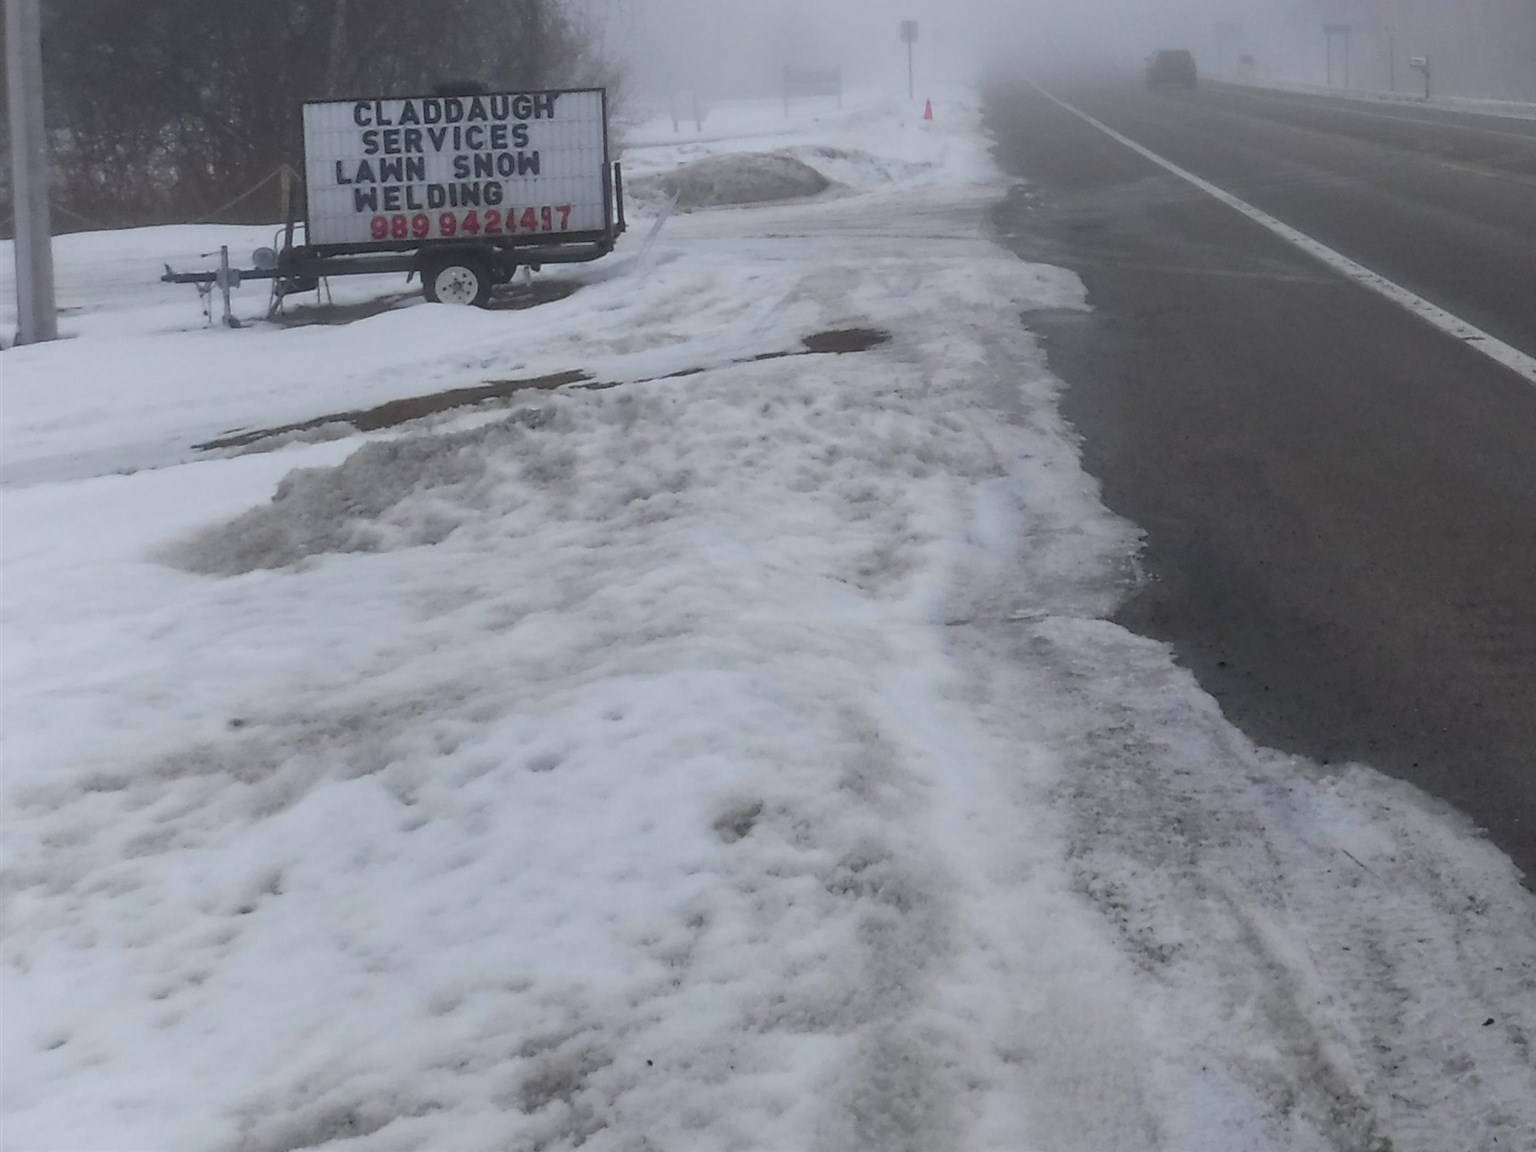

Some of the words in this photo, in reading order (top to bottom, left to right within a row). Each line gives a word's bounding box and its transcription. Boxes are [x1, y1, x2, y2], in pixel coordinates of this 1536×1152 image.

[353, 94, 555, 126] CLADDAUGH
[362, 124, 529, 154] SERVICES
[335, 157, 425, 184] LAWN
[453, 151, 540, 179] SNOW
[354, 182, 503, 212] WELDING
[370, 214, 430, 239] 989
